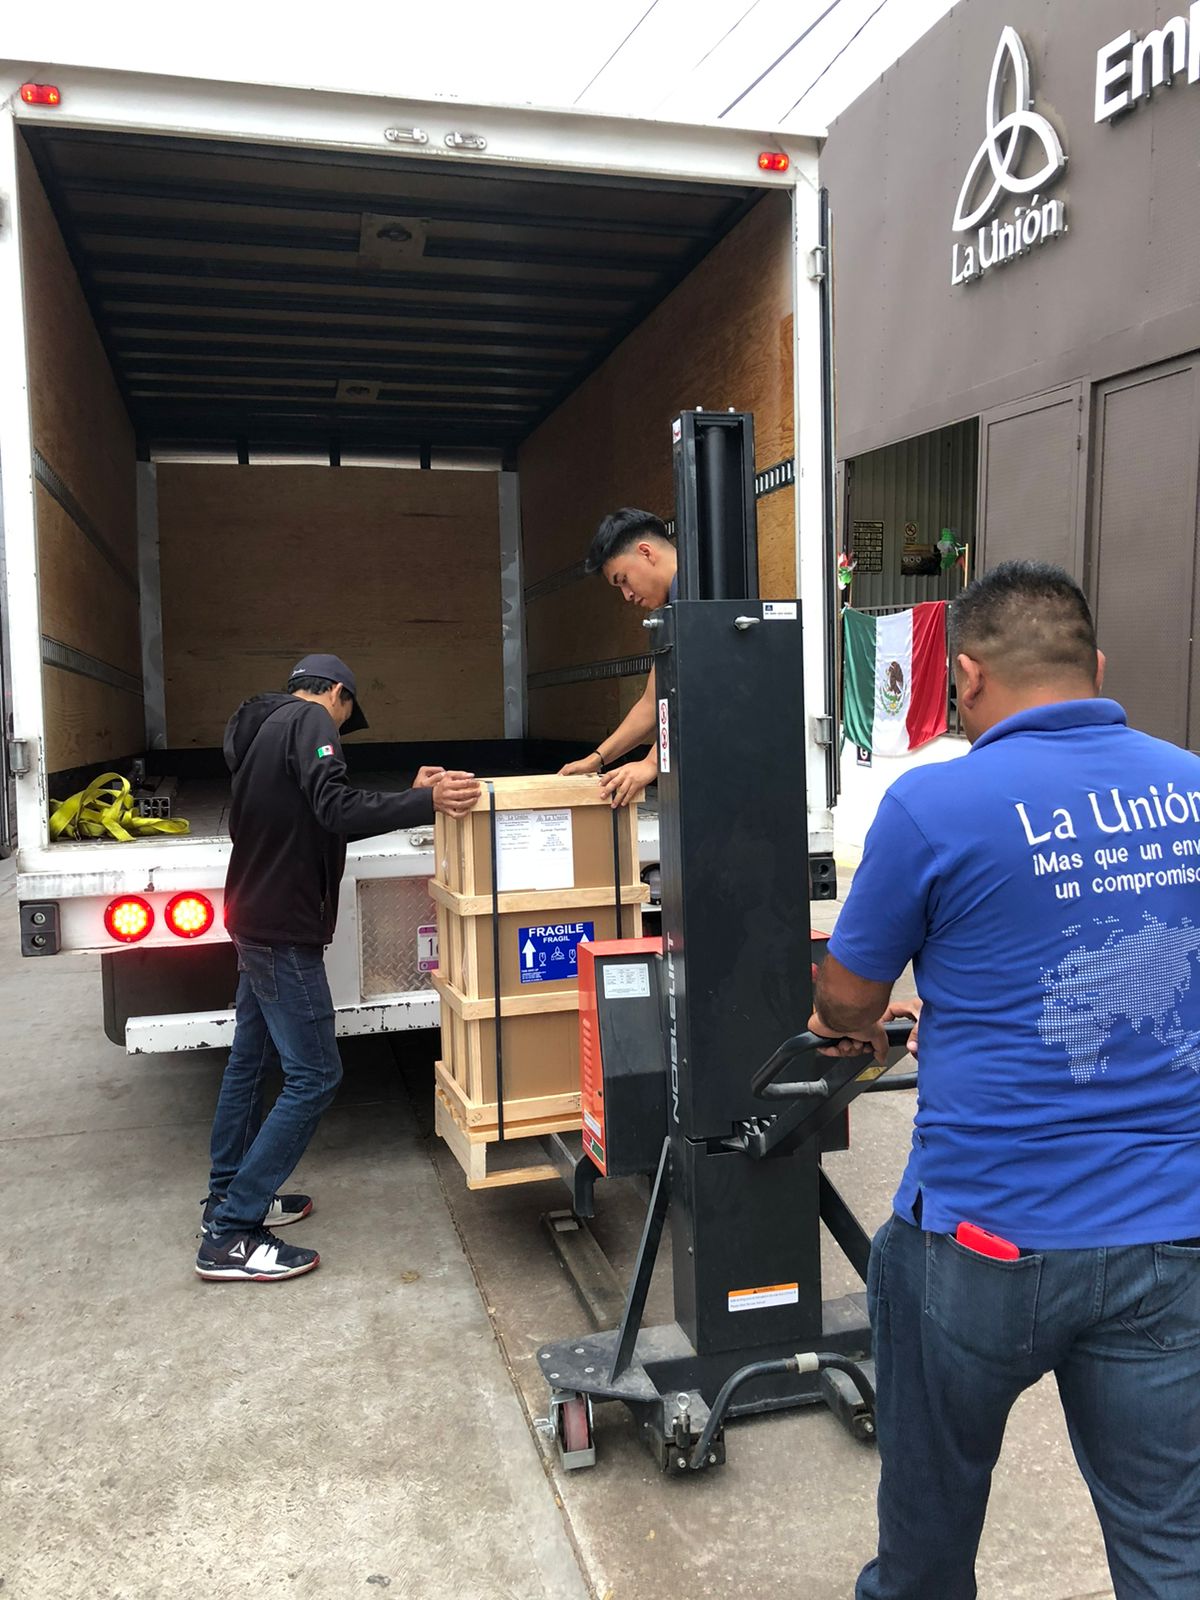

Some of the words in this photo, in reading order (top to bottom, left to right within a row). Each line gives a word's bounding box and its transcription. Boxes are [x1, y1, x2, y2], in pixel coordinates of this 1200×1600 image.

[951, 243, 975, 286] La
[979, 194, 1060, 269] Unión
[1015, 802, 1076, 846] La
[1094, 846, 1129, 870] que
[1140, 842, 1163, 861] un
[1055, 880, 1081, 900] un
[528, 923, 584, 938] FRAGILE
[667, 932, 680, 1124] NOBLELIFT
